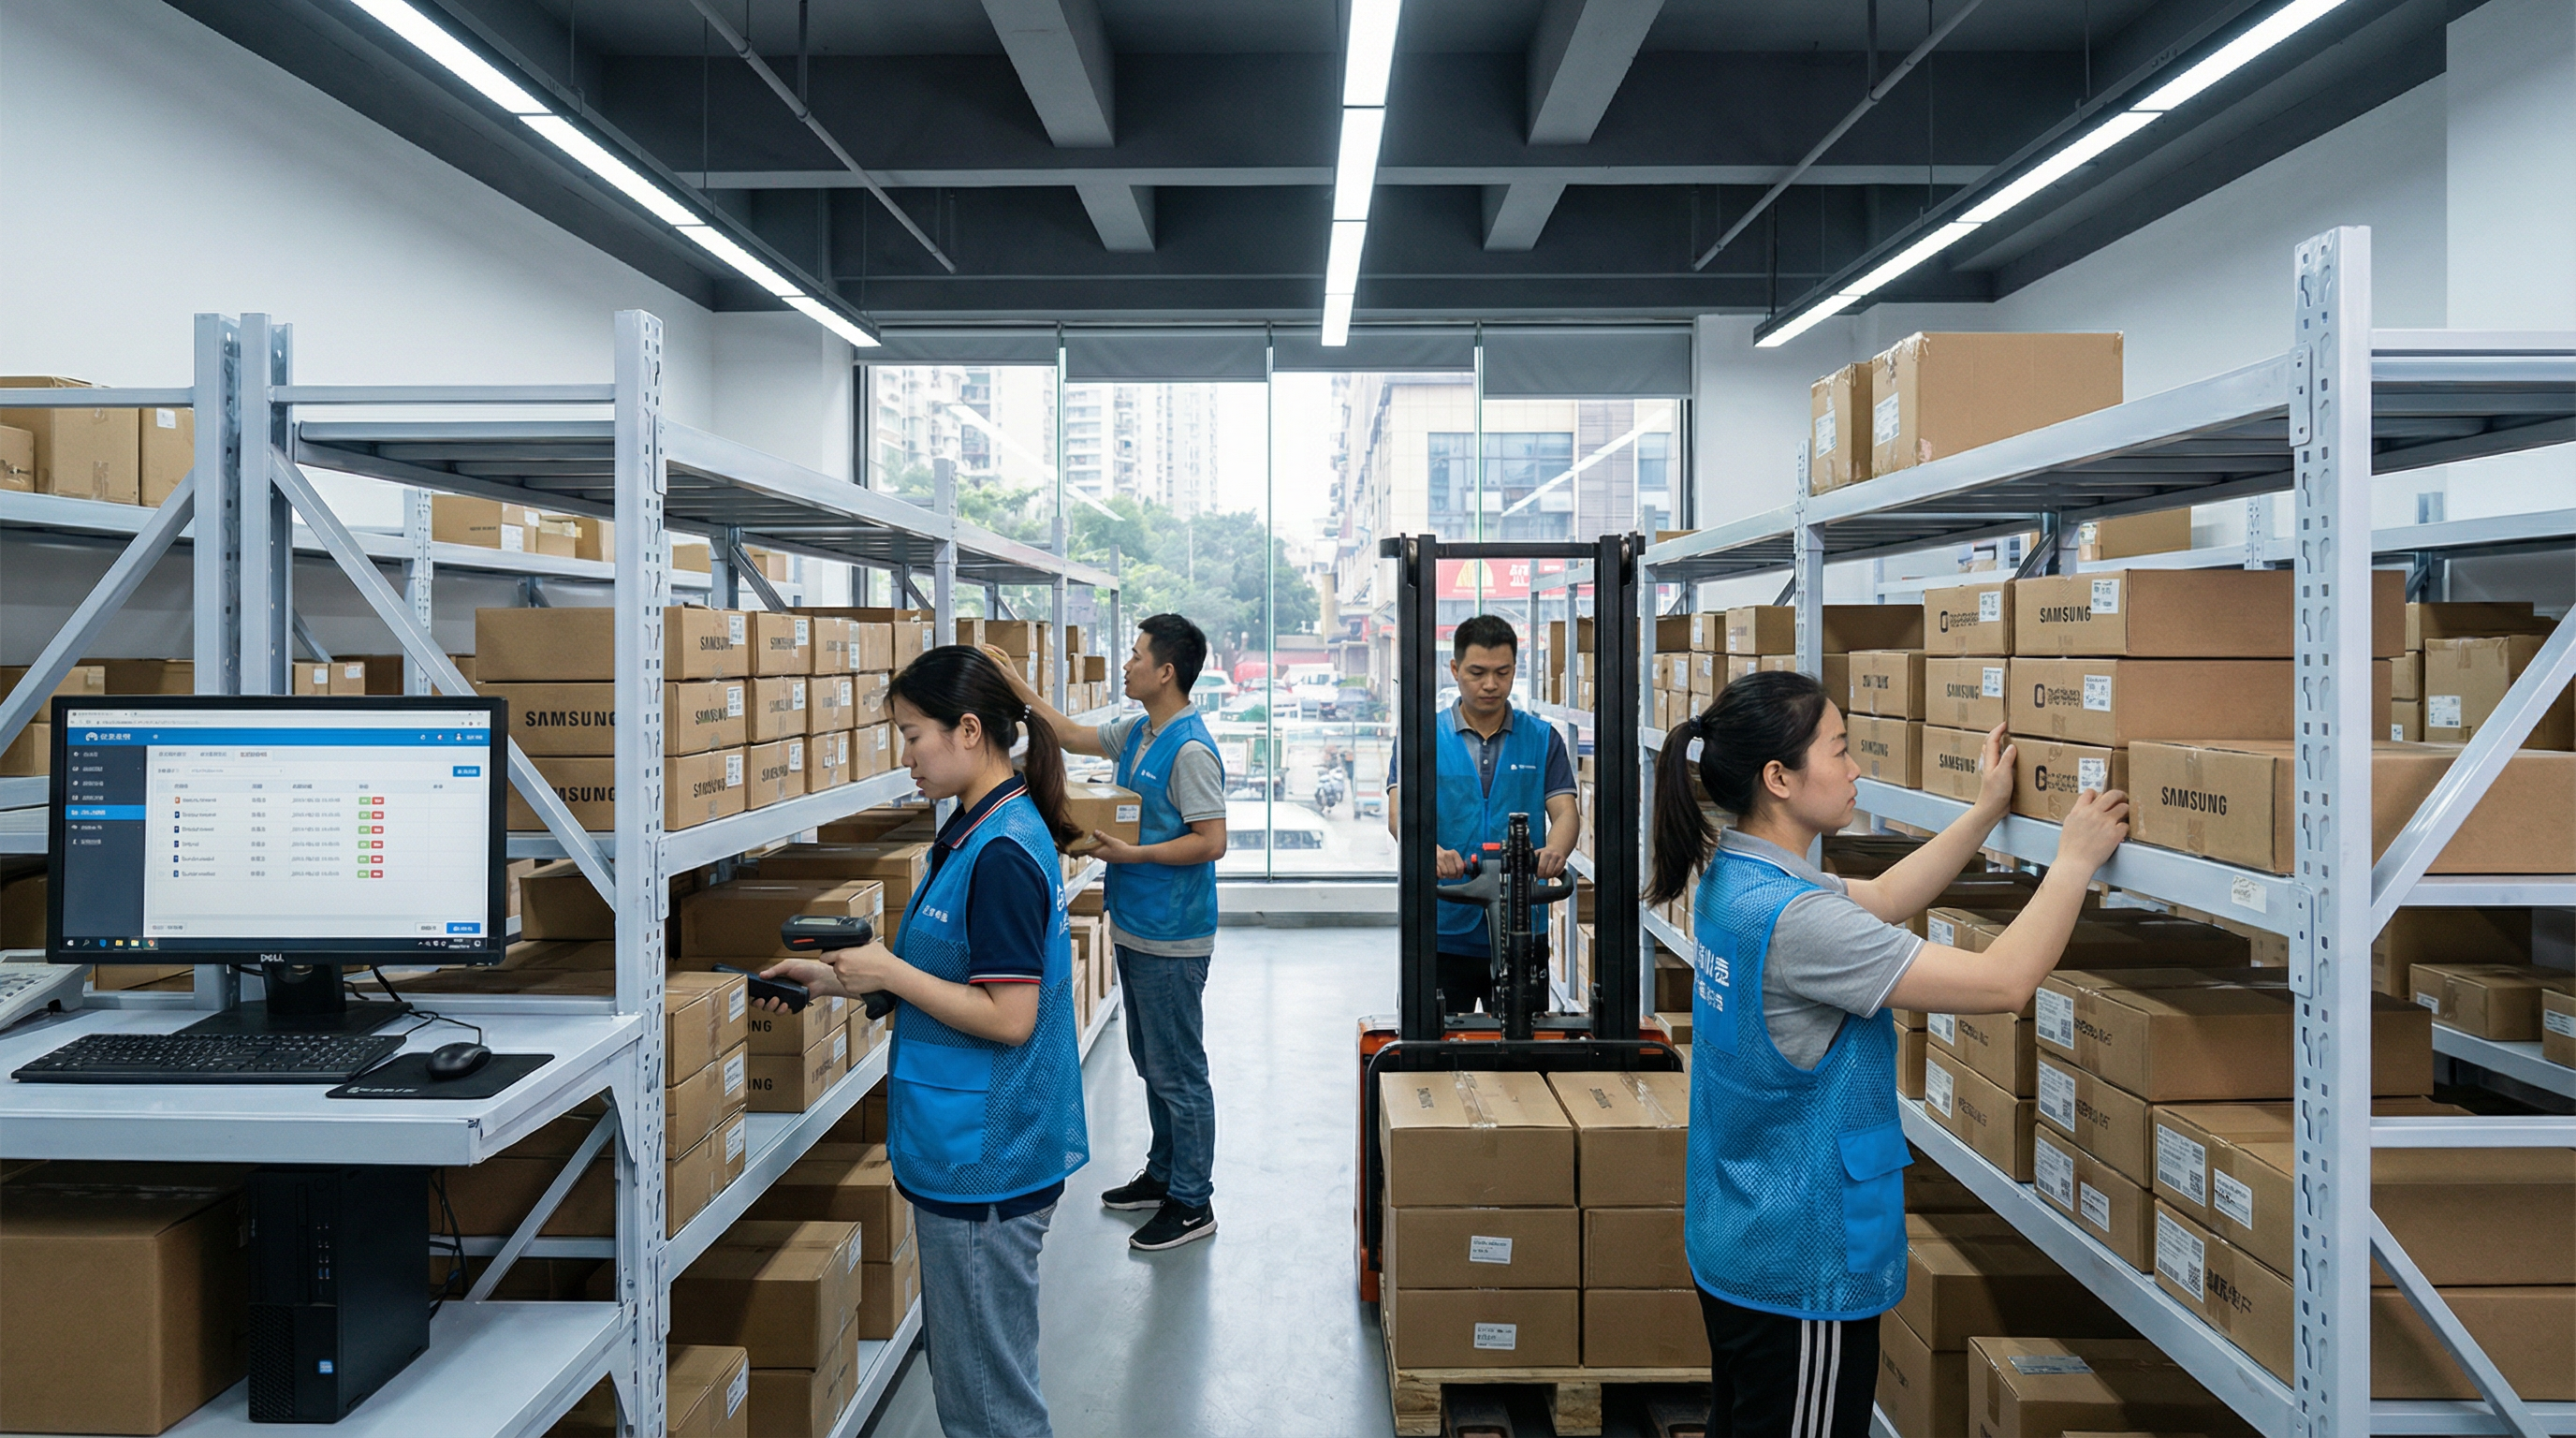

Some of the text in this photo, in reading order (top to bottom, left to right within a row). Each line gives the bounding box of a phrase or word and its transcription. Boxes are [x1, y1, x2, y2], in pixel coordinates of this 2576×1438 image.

[2040, 606, 2092, 624] SAMSUNG
[2161, 785, 2227, 816] SAMSUNG
[260, 953, 285, 963] DELL
